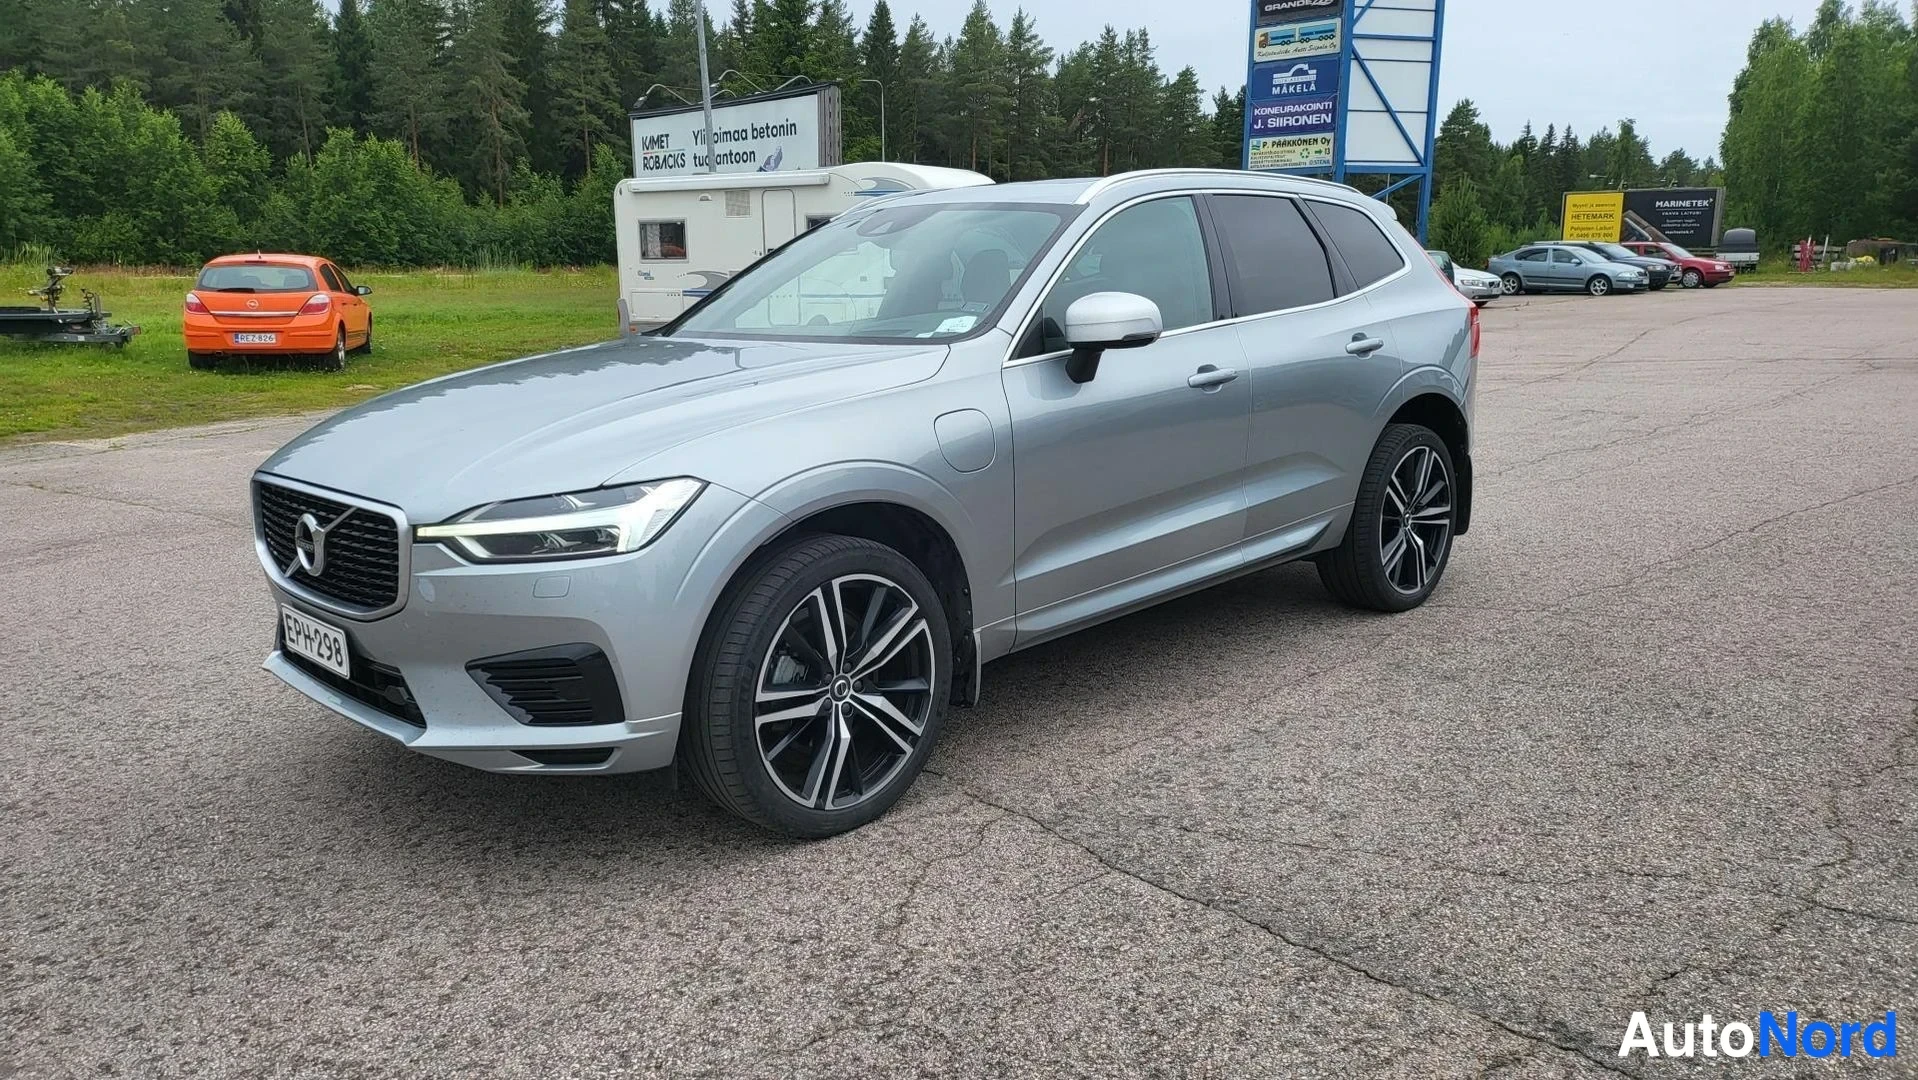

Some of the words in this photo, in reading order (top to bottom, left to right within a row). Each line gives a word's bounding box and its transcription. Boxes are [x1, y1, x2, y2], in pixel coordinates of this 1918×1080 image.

[1272, 81, 1316, 95] MÄKELÄ
[1254, 101, 1333, 116] KONEURAKOINTI
[1253, 119, 1265, 129] J.
[1267, 112, 1332, 128] SIIRONEN
[692, 126, 748, 147] Ylioimaa
[750, 118, 797, 140] betonin
[641, 133, 670, 152] KAMET
[1262, 141, 1270, 149] P.
[1320, 136, 1331, 146] Oy
[642, 152, 686, 172] ROBACKS
[692, 149, 756, 168] tuoantoon
[1655, 199, 1709, 208] MARINETEK
[1571, 213, 1615, 221] HETEMARK
[239, 333, 275, 344] REZ-826
[284, 612, 344, 668] EPH-298
